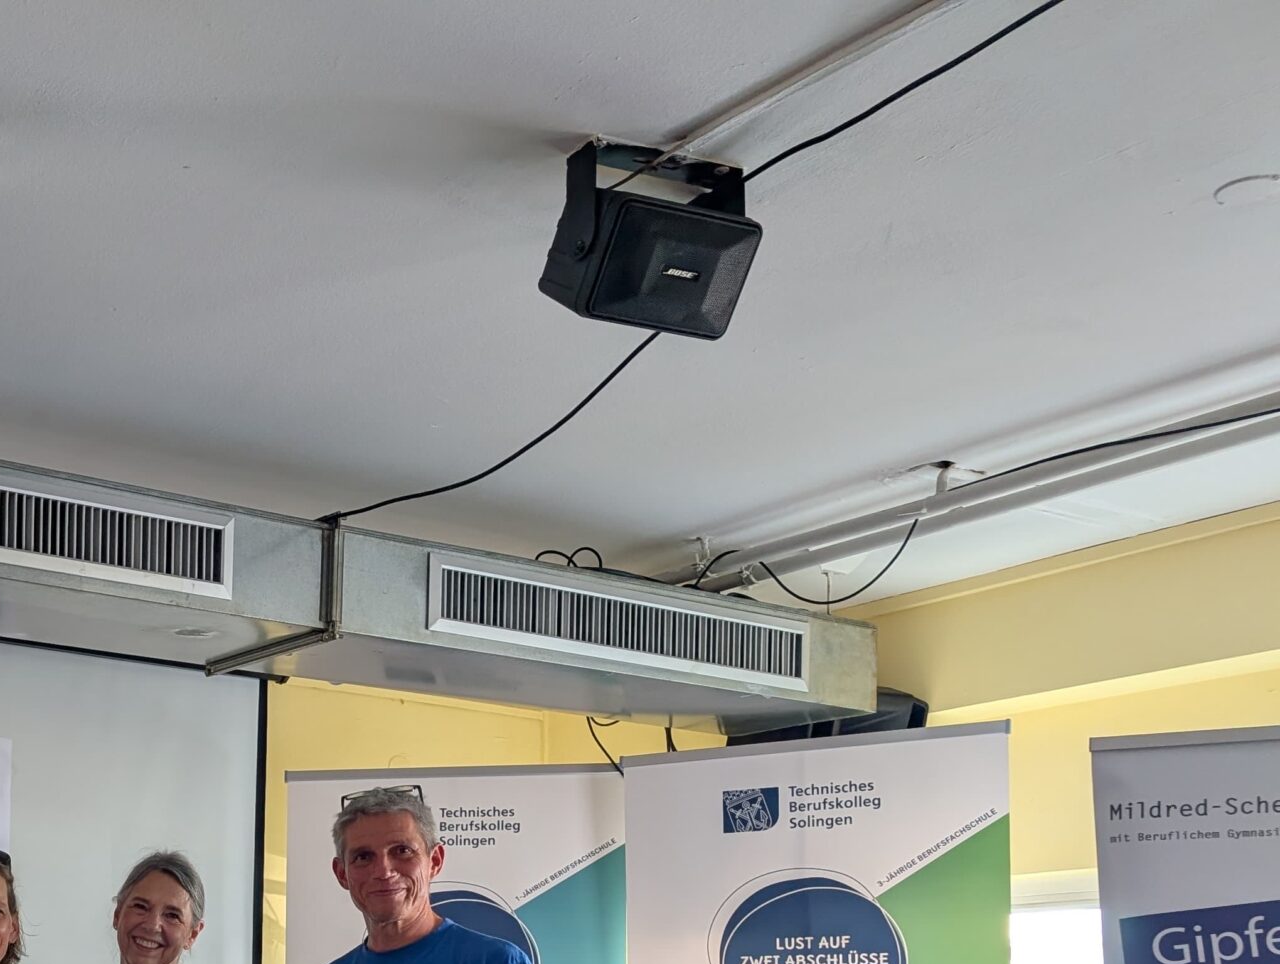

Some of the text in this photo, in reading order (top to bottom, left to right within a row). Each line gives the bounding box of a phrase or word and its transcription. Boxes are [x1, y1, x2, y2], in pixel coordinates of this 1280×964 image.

[788, 780, 874, 797] Technisches
[789, 795, 881, 813] Berufskolleg
[439, 806, 515, 819] Technisches
[439, 820, 521, 833] Berufskolleg
[789, 815, 853, 830] Solingen
[439, 835, 496, 848] Solingen
[1110, 833, 1131, 843] mit
[1137, 830, 1220, 842] Beruflichem
[877, 807, 998, 888] 3-JÄHRIGE BERUFSFACHSCHULE
[515, 838, 617, 902] 1-JÄHRIGE BERUFSFACHSCHULE
[776, 936, 851, 950] LUST AUF
